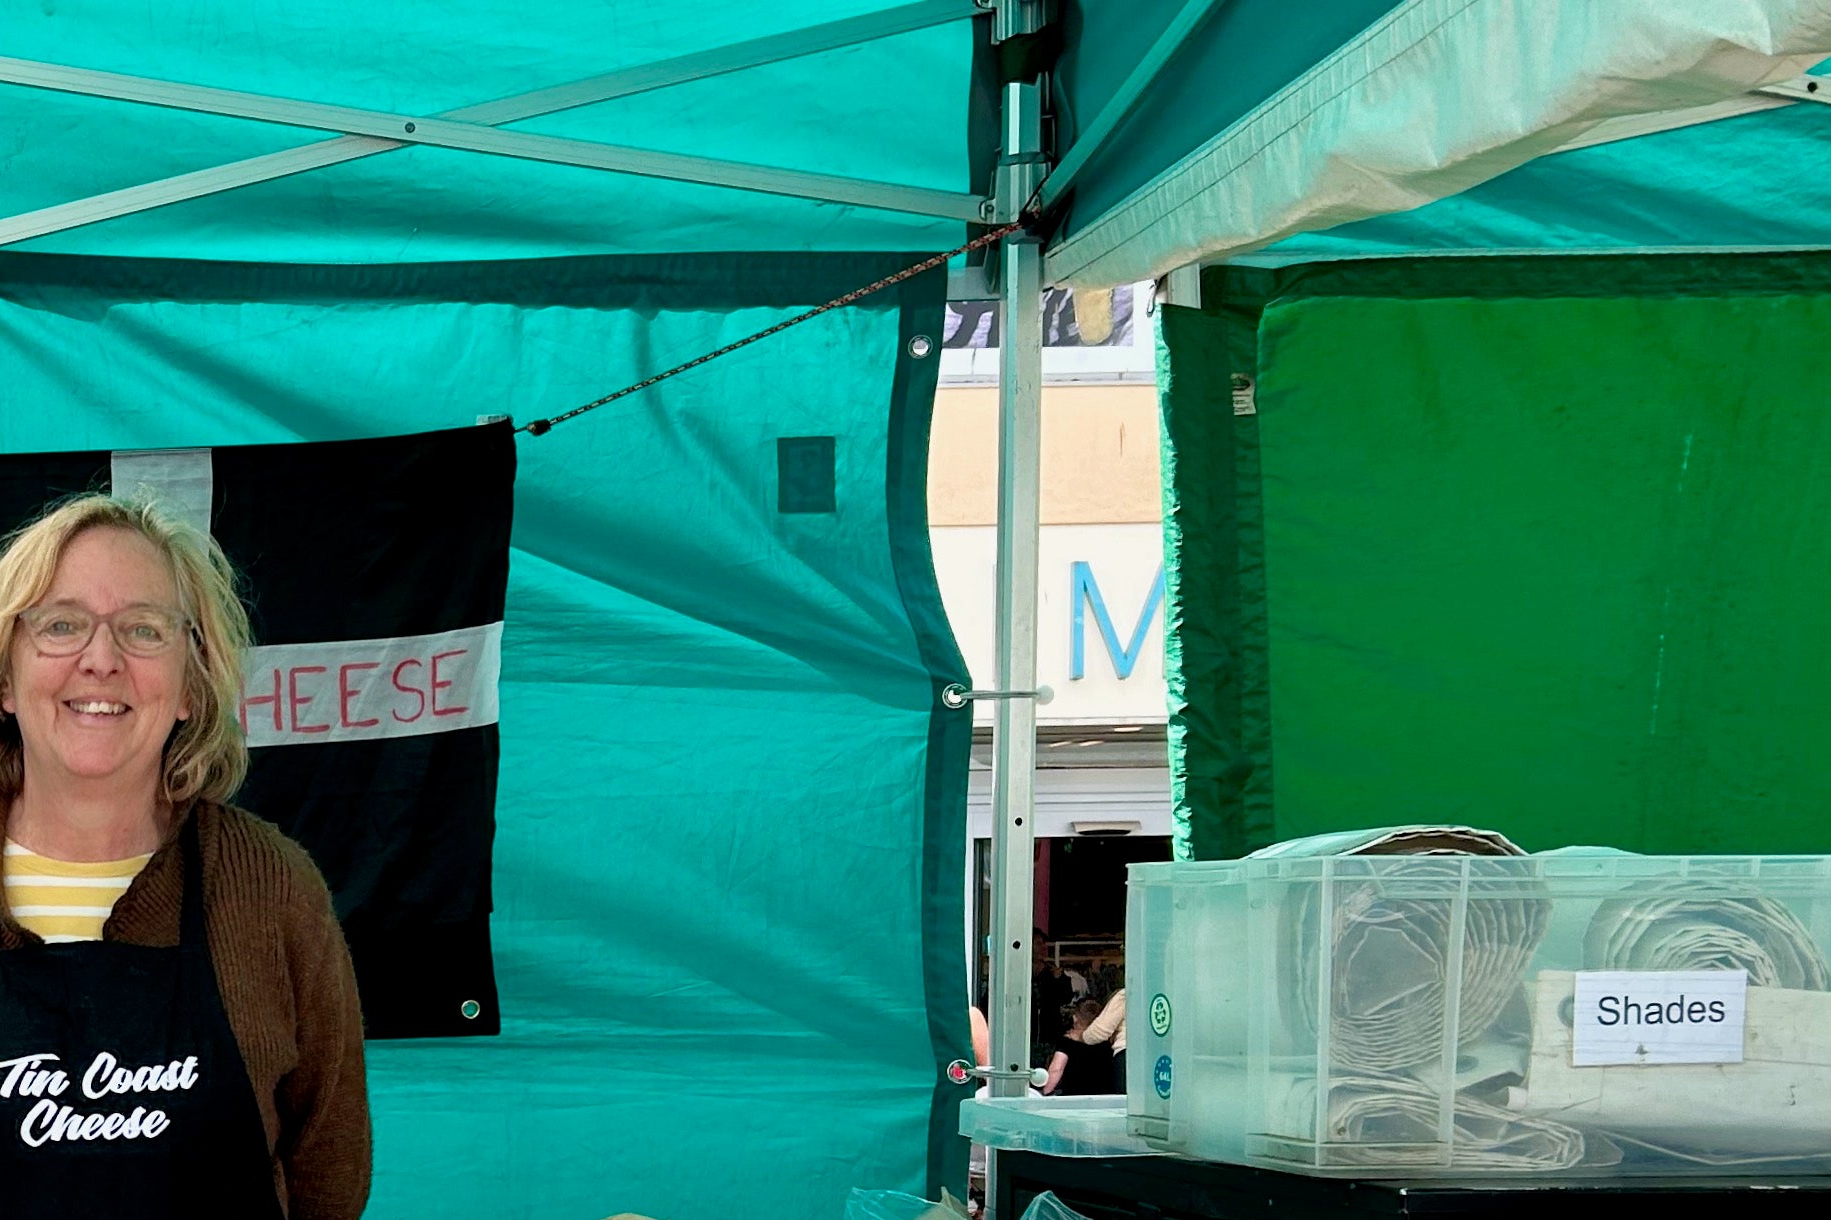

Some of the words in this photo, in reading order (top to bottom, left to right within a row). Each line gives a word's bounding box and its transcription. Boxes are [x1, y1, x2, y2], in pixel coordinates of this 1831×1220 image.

[238, 649, 469, 735] HEESE
[1596, 994, 1726, 1026] Shades
[81, 1051, 199, 1099] Coast
[20, 1098, 171, 1148] Cheese
